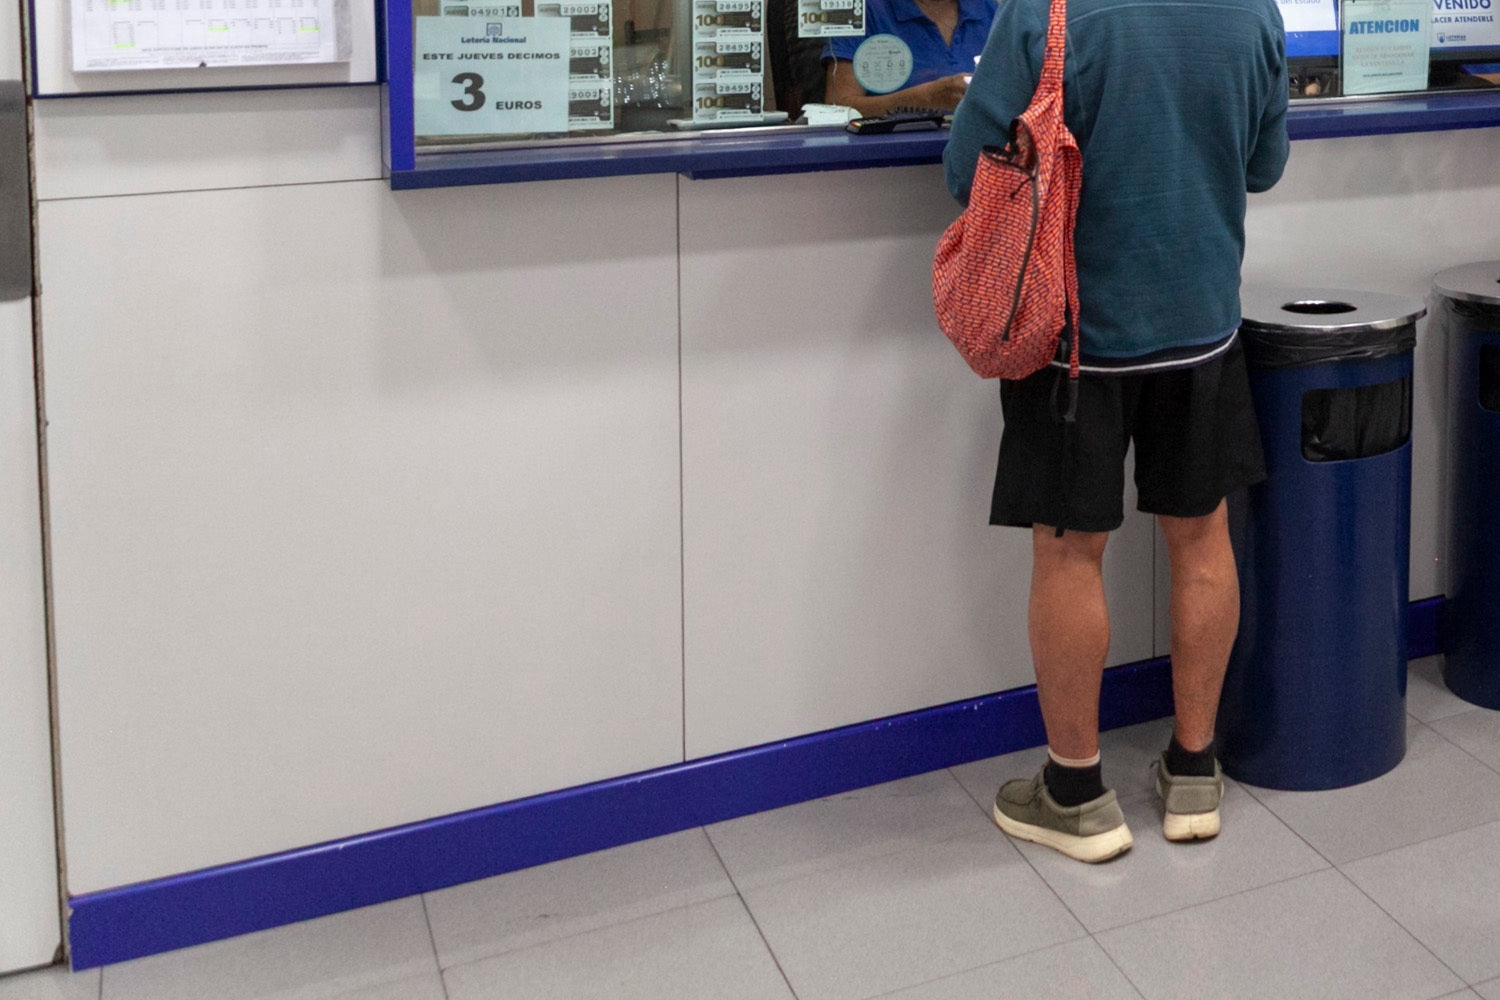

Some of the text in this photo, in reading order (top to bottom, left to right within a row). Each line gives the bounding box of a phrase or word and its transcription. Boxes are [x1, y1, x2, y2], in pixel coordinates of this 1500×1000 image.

[1350, 19, 1419, 34] ATENCION
[1455, 15, 1494, 23] ATENDERLE
[450, 72, 542, 112] 3 EUROS
